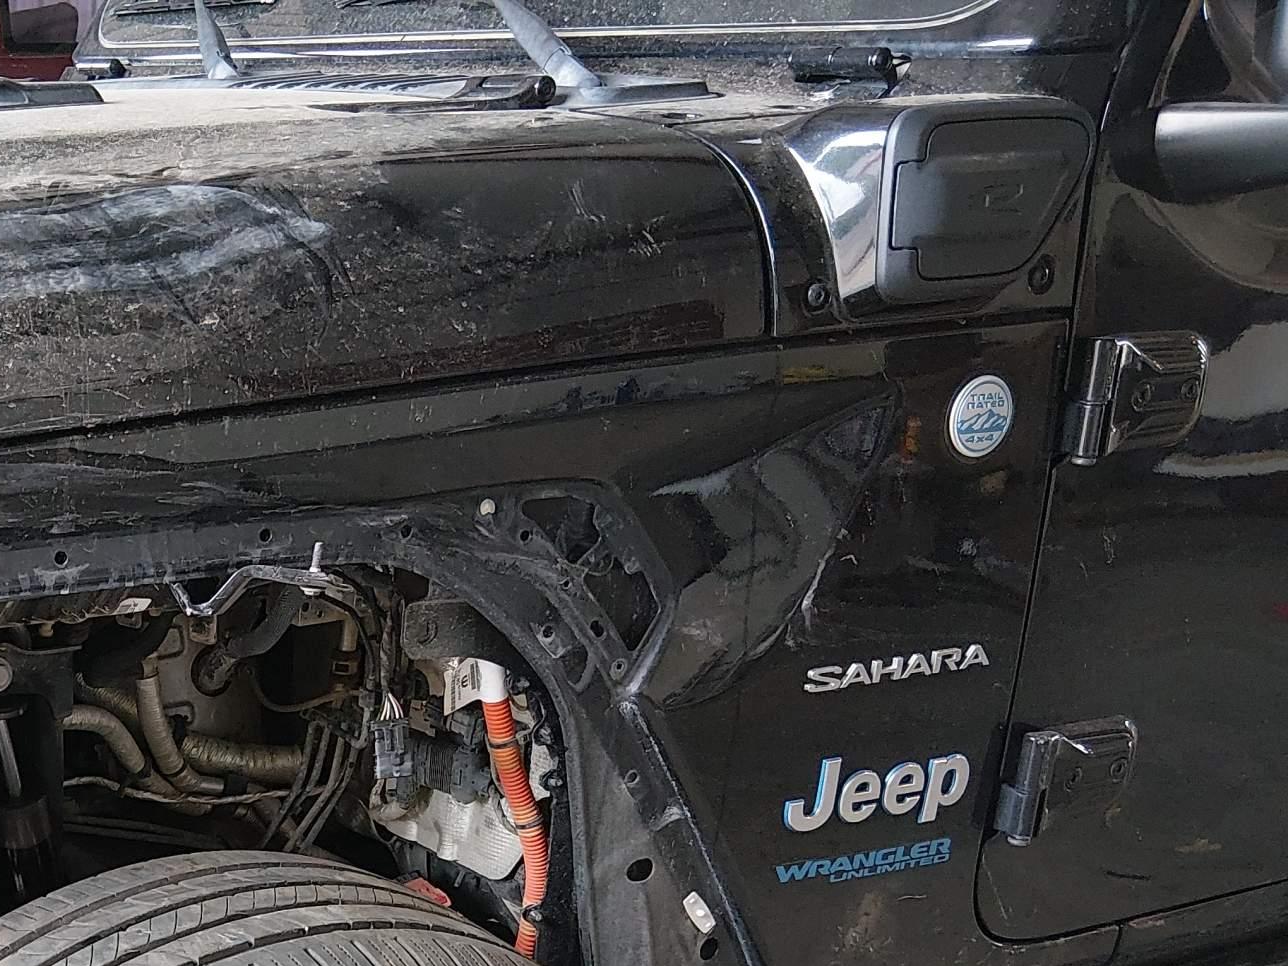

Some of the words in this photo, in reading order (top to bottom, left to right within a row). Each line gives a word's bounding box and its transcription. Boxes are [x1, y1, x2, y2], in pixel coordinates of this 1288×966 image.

[803, 643, 990, 693] SAHARA
[784, 753, 971, 832] Jeep
[775, 838, 952, 883] WRANGLER
[828, 853, 951, 883] UNLIMITED
